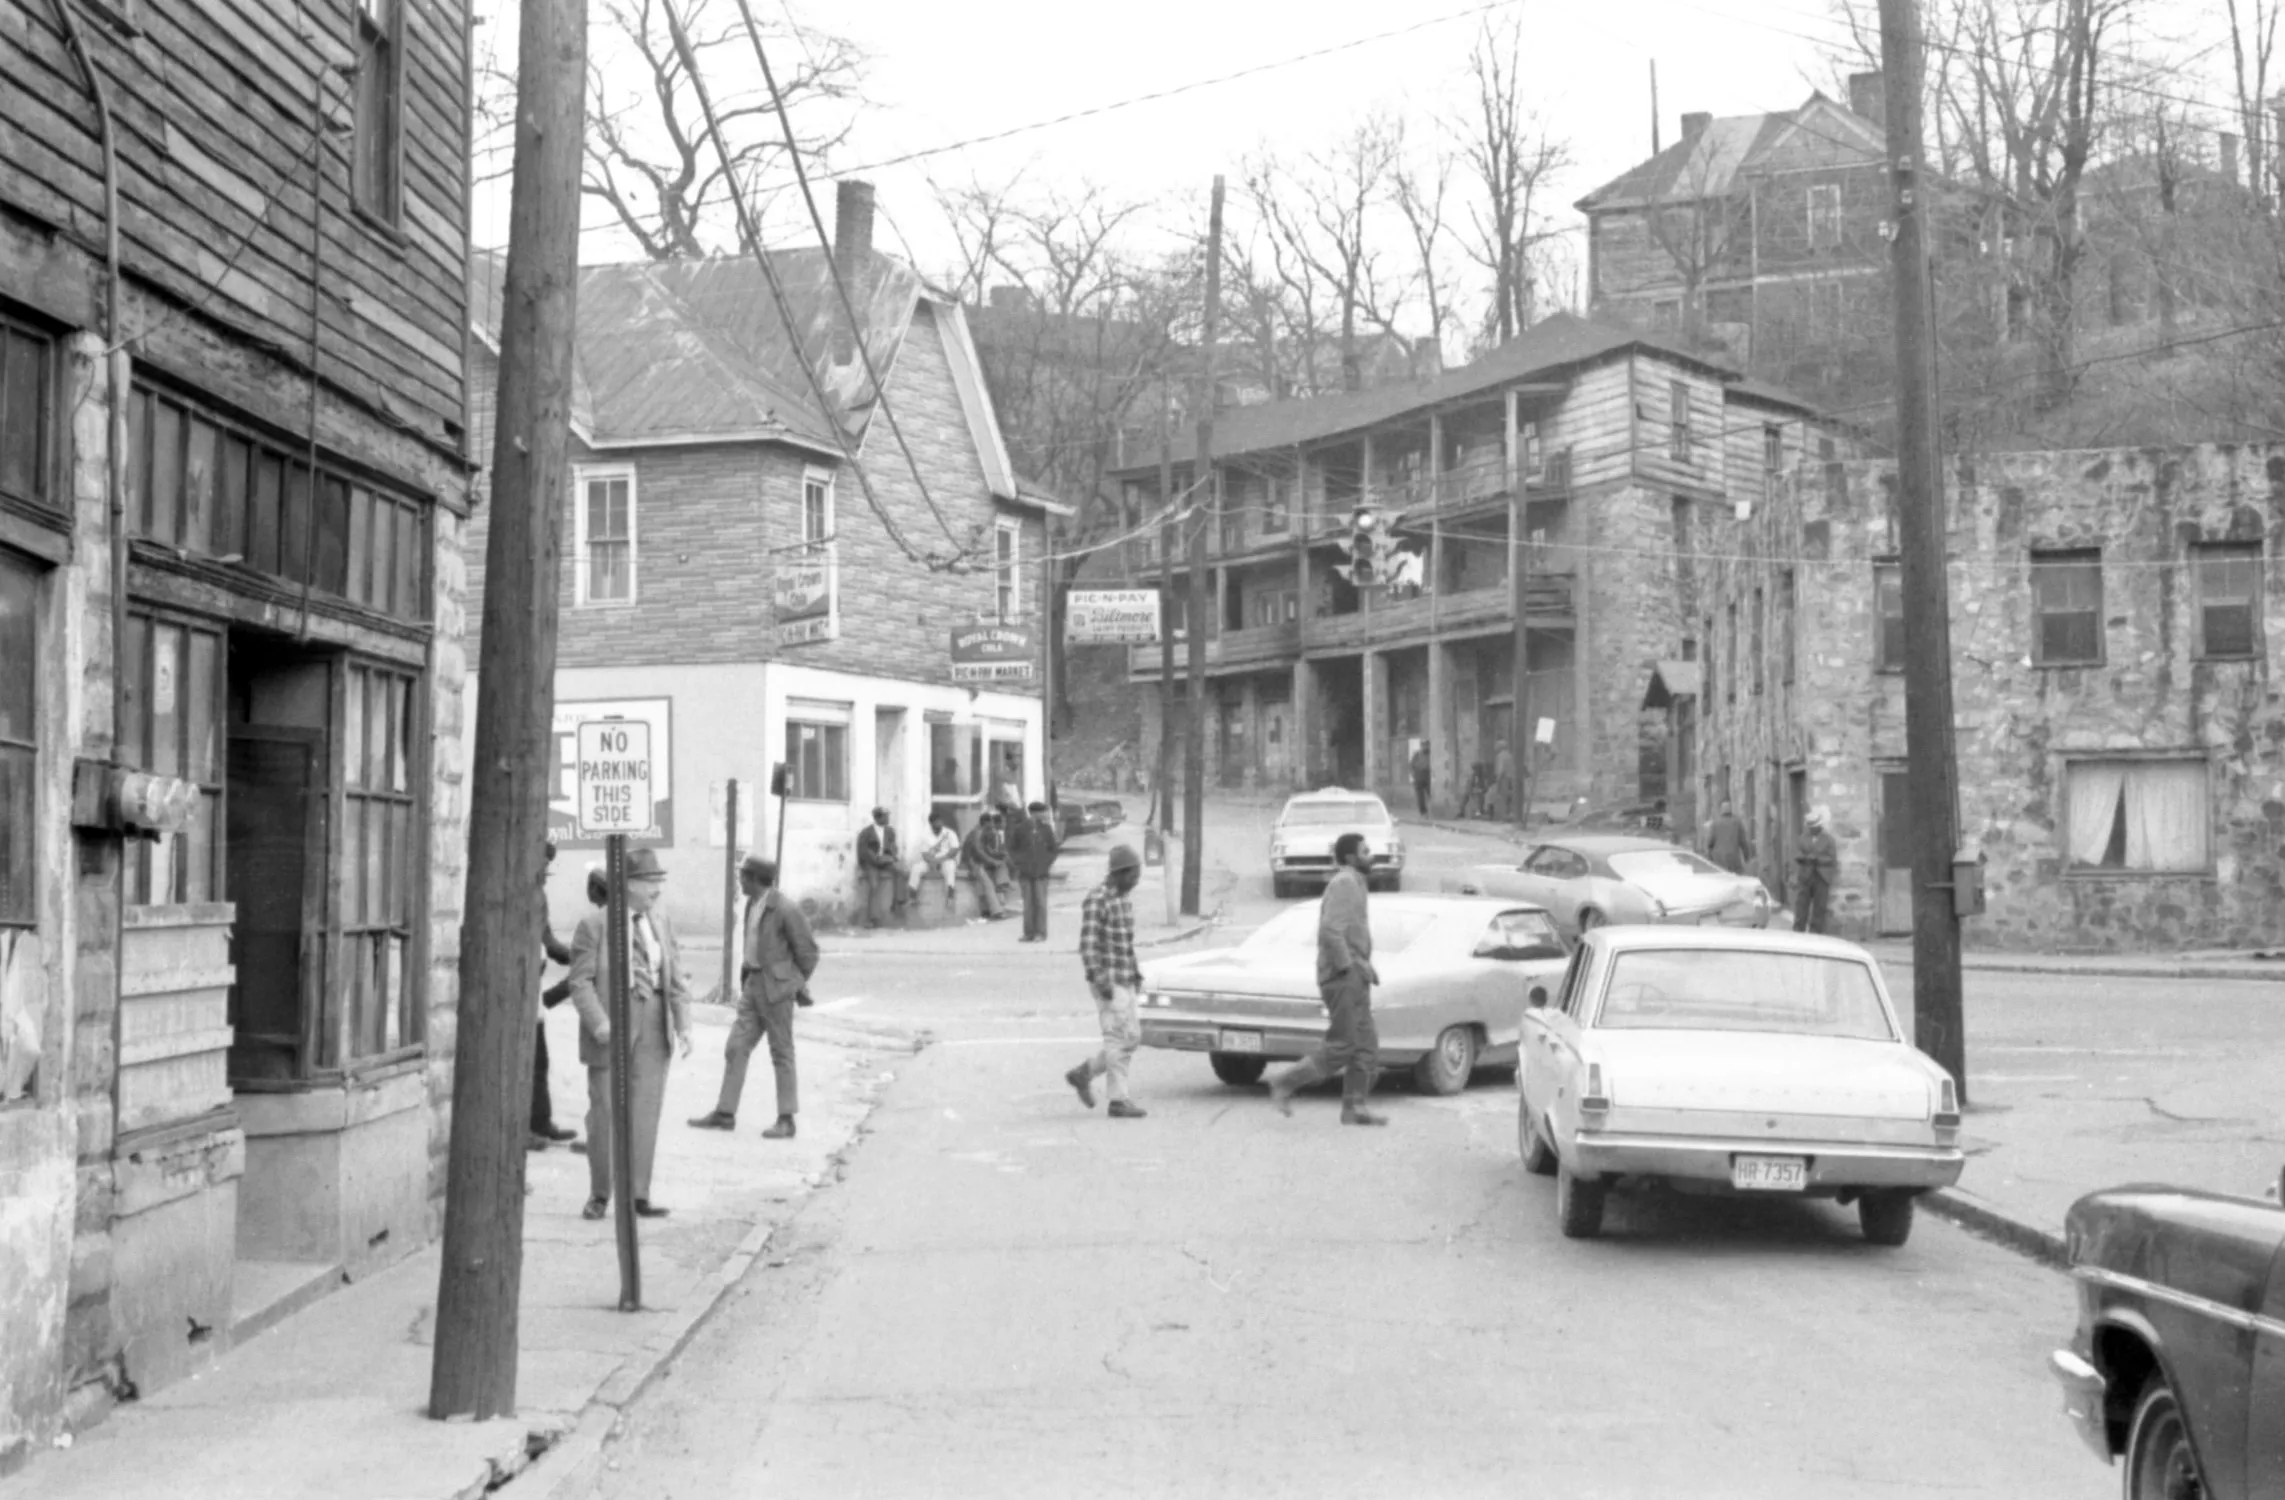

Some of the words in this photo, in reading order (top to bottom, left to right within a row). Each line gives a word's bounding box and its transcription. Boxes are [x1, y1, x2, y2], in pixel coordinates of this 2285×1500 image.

[1073, 593, 1148, 605] PIC-N-PAY
[1090, 606, 1154, 623] Biltmore
[957, 630, 990, 649] ROYAL
[990, 628, 1027, 649] CROWN
[980, 642, 1004, 653] COLA
[994, 664, 1030, 679] MARKET
[600, 731, 628, 753] NO
[581, 760, 648, 782] PARKING
[592, 784, 632, 804] THIS
[593, 805, 632, 823] SIDE
